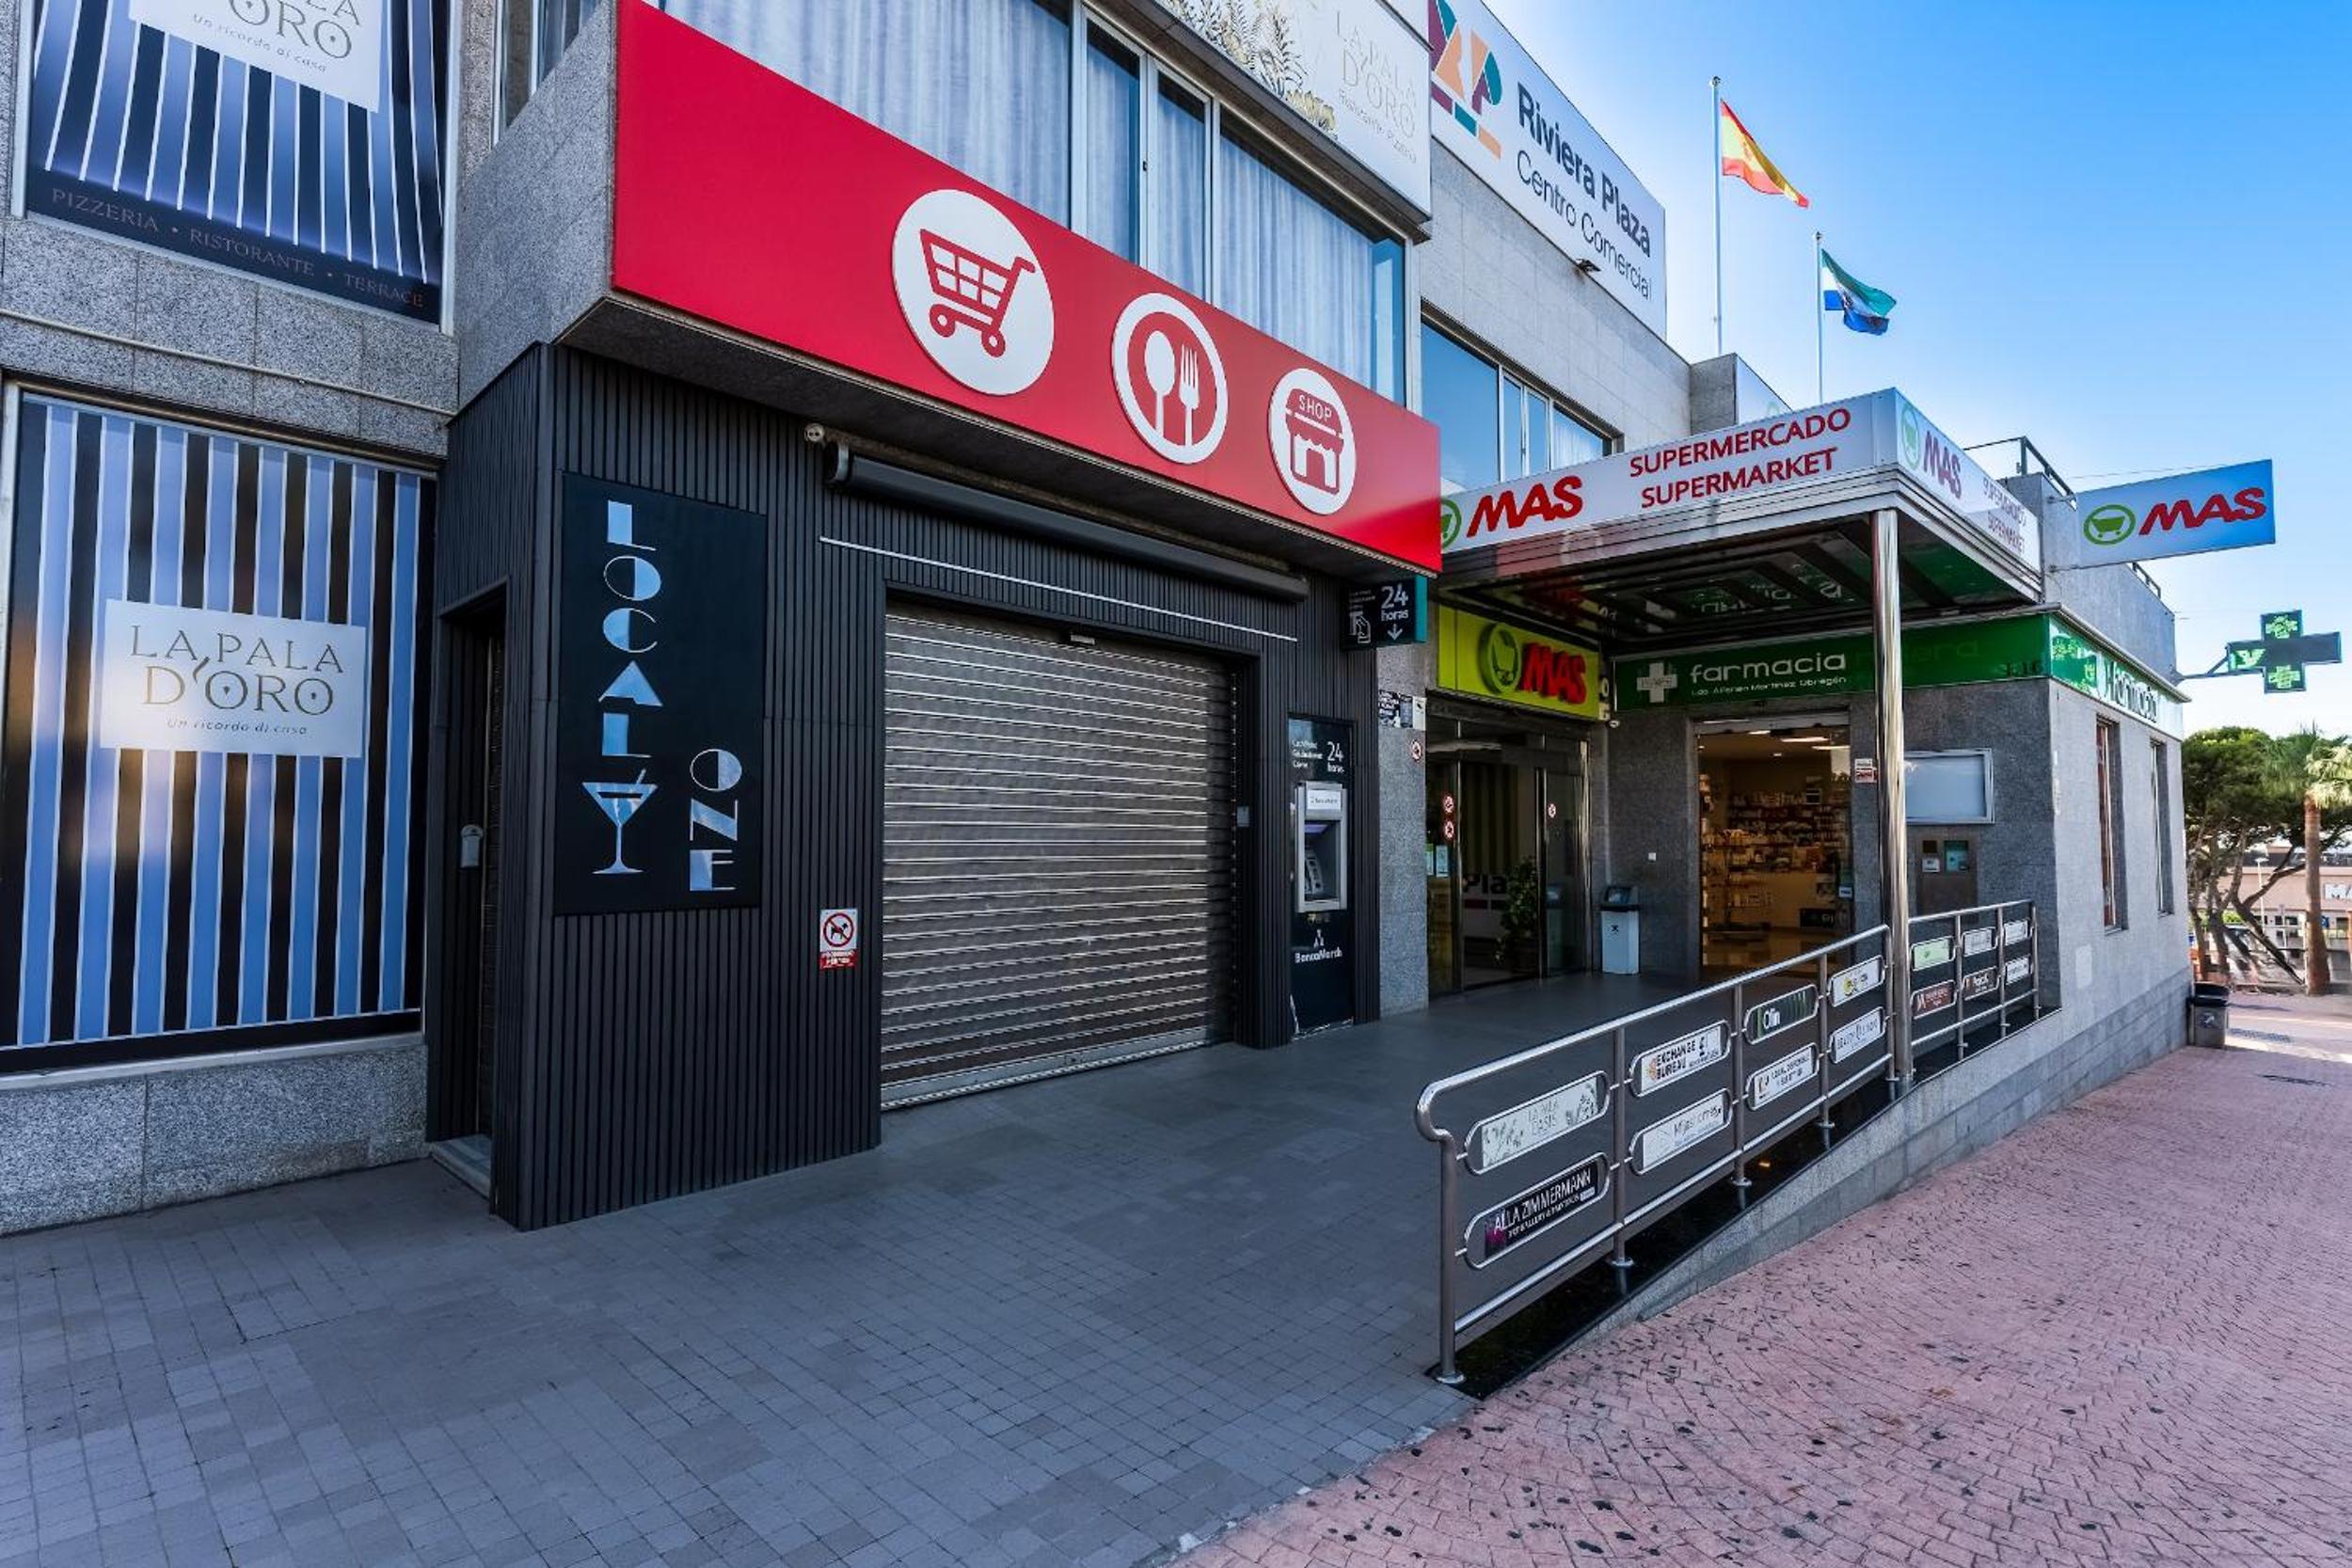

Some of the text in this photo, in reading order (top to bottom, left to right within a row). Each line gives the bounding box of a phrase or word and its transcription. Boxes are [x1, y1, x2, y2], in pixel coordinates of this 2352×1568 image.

[1517, 81, 1652, 259] Riviera Plaza
[52, 188, 425, 308] PIZZERIA RISTORANTE TERRACE
[1517, 148, 1653, 302] Centro Comercial
[1299, 393, 1333, 422] SHOP
[1629, 407, 1851, 477] SUPERMERCADO
[1924, 431, 1963, 500] MAS
[1466, 474, 1583, 538] MAS
[1641, 447, 1838, 509] SUPERMARKET
[2138, 487, 2266, 535] MAS
[1381, 583, 1409, 609] 24
[1381, 609, 1409, 622] horas
[130, 625, 344, 673] LA PALA
[1517, 642, 1587, 705] MAS
[1690, 652, 1847, 684] farmacia
[143, 657, 334, 716] D'ORO
[1327, 740, 1344, 762] 24
[689, 748, 743, 892] ONE
[1656, 1040, 1696, 1067] EXCHANGE
[1521, 1167, 1592, 1219] ZIMMERMANN
